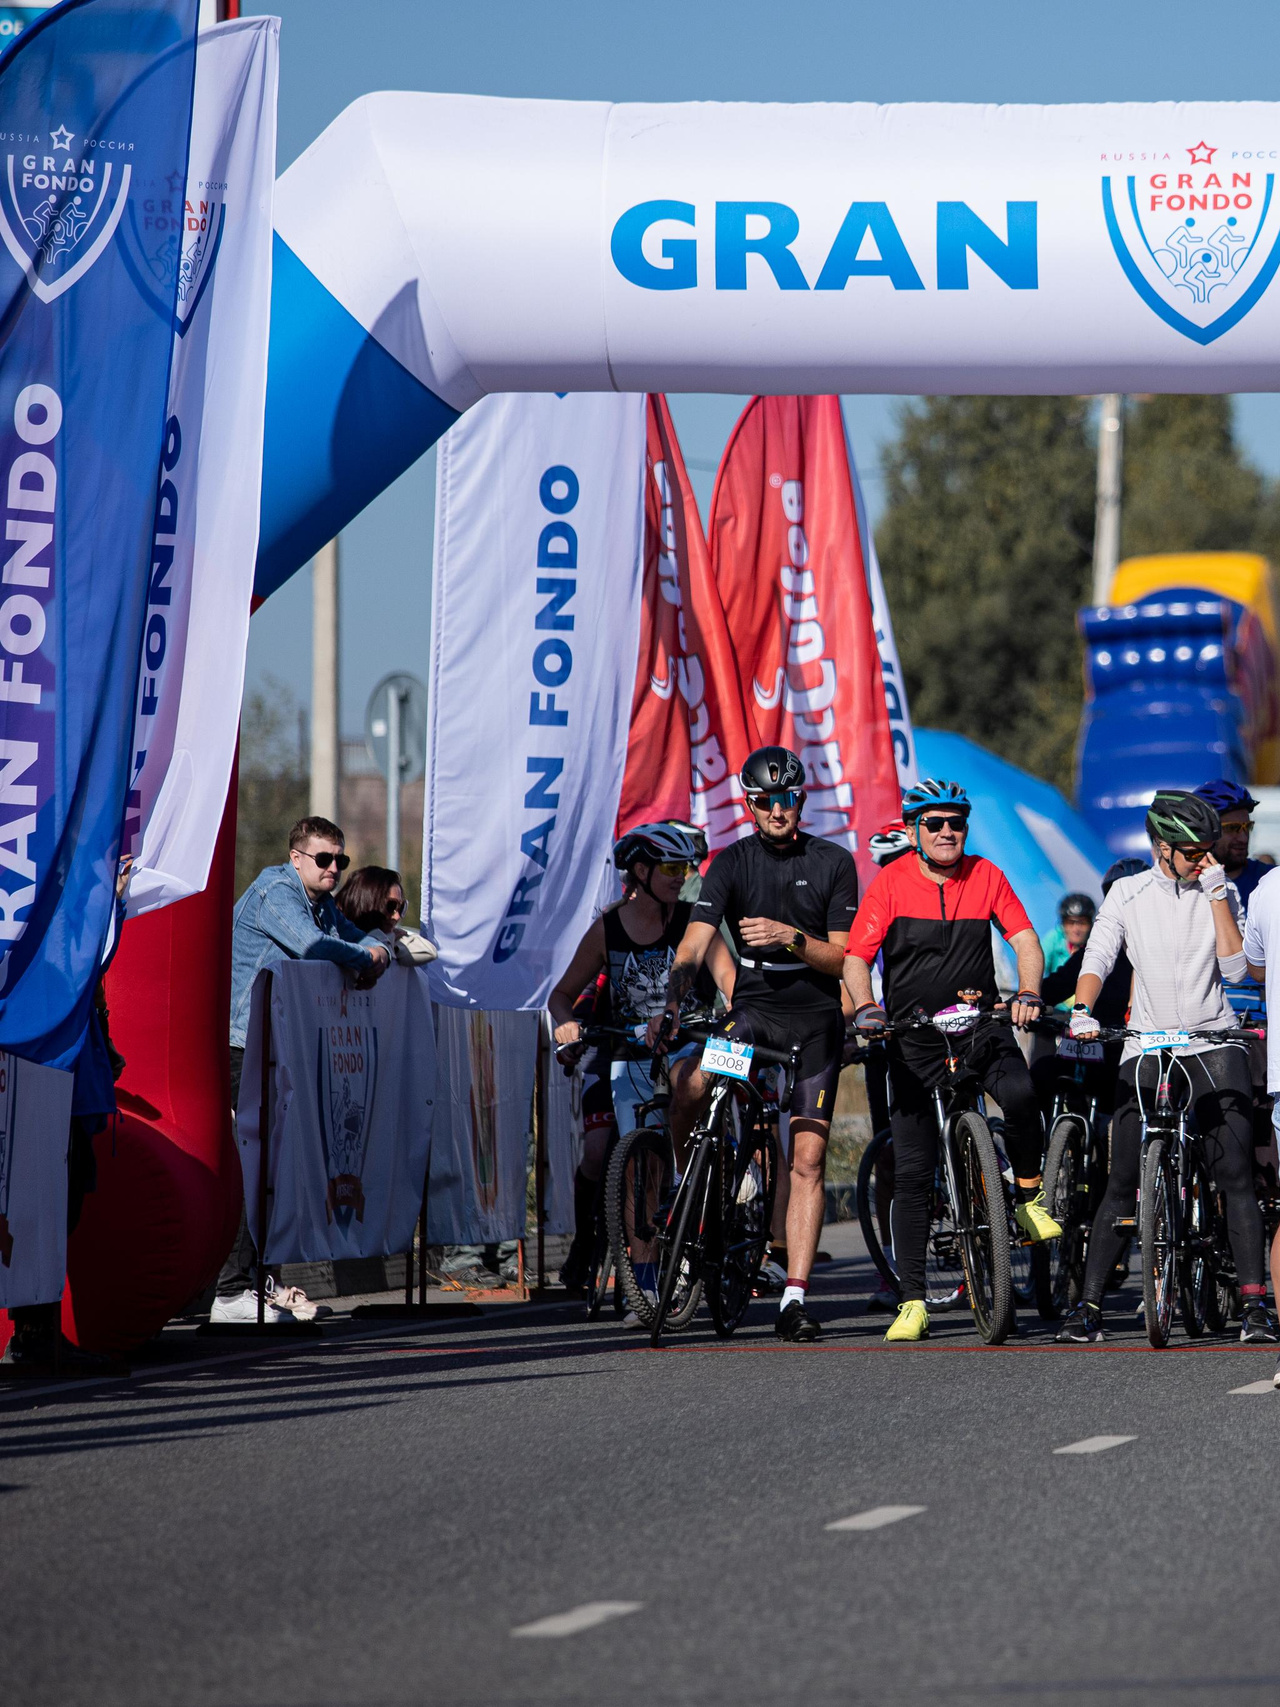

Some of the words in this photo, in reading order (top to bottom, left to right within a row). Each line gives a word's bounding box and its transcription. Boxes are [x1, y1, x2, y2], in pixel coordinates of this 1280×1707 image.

[0, 132, 40, 143] USSIA
[83, 138, 135, 151] РОССИЯ
[22, 154, 95, 175] GRAN
[1100, 152, 1171, 161] RUSSIA
[22, 173, 95, 193] FONDO
[1149, 172, 1251, 190] GRAN
[1150, 193, 1253, 212] FONDO
[610, 199, 1039, 291] GRAN
[0, 383, 63, 705] FONDO
[140, 414, 182, 716] FONDO
[492, 757, 564, 964] GRAN
[529, 465, 580, 727] FONDO
[0, 738, 39, 992] RAN
[330, 1025, 362, 1047] GRAN
[1148, 1035, 1181, 1045] 3010
[332, 1052, 364, 1074] FONDO
[708, 1053, 744, 1072] 3008
